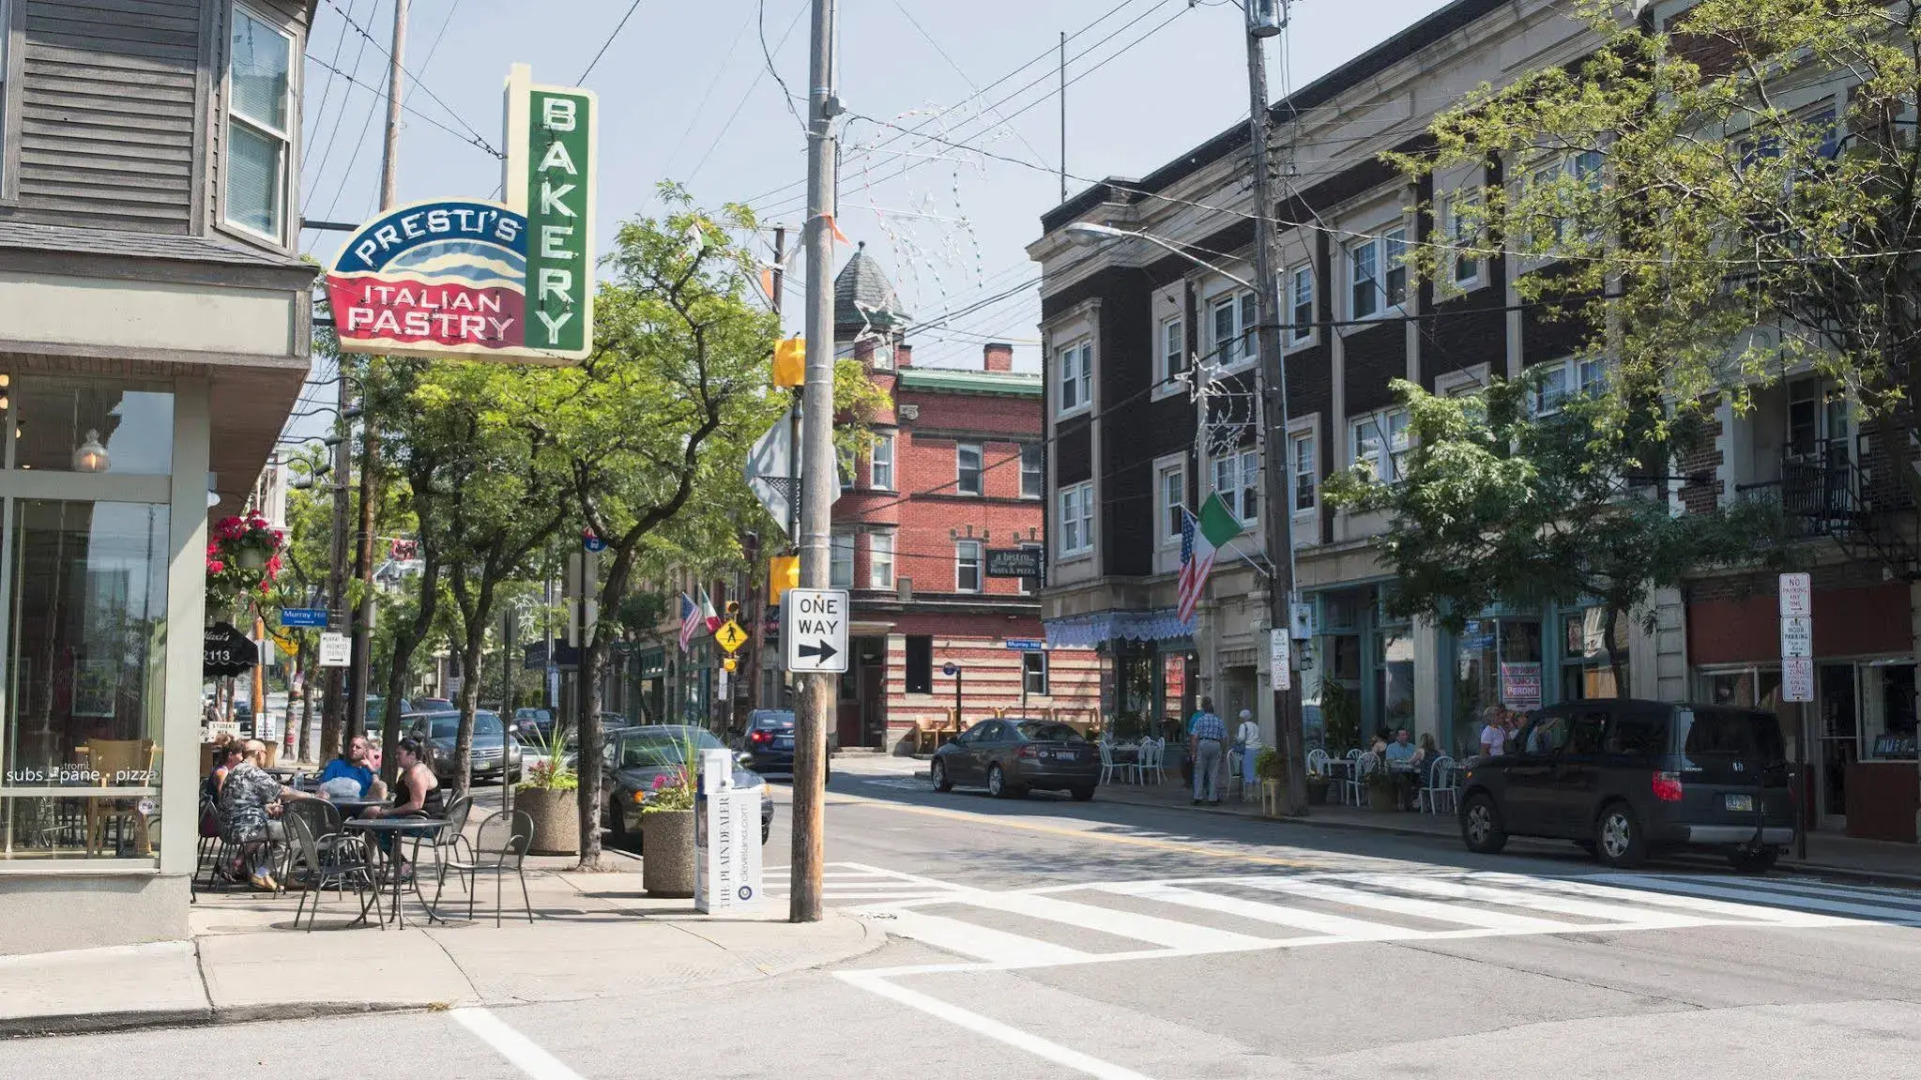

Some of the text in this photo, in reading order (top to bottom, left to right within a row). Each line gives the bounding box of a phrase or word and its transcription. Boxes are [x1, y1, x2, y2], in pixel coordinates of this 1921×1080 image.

[535, 97, 578, 345] BAKERY
[355, 209, 523, 270] PRESTI'S
[363, 284, 501, 313] ITALIAN
[348, 307, 515, 341] PASTRY
[1789, 578, 1801, 586] NO
[284, 610, 312, 619] Murray
[800, 599, 838, 614] ONE
[798, 620, 839, 635] WAY
[1007, 641, 1030, 649] Murray
[204, 650, 230, 661] 2113
[6, 766, 158, 783] subs pane pizza
[740, 803, 749, 882] cleveland.com
[719, 797, 730, 909] THE PLAIN DEALER
